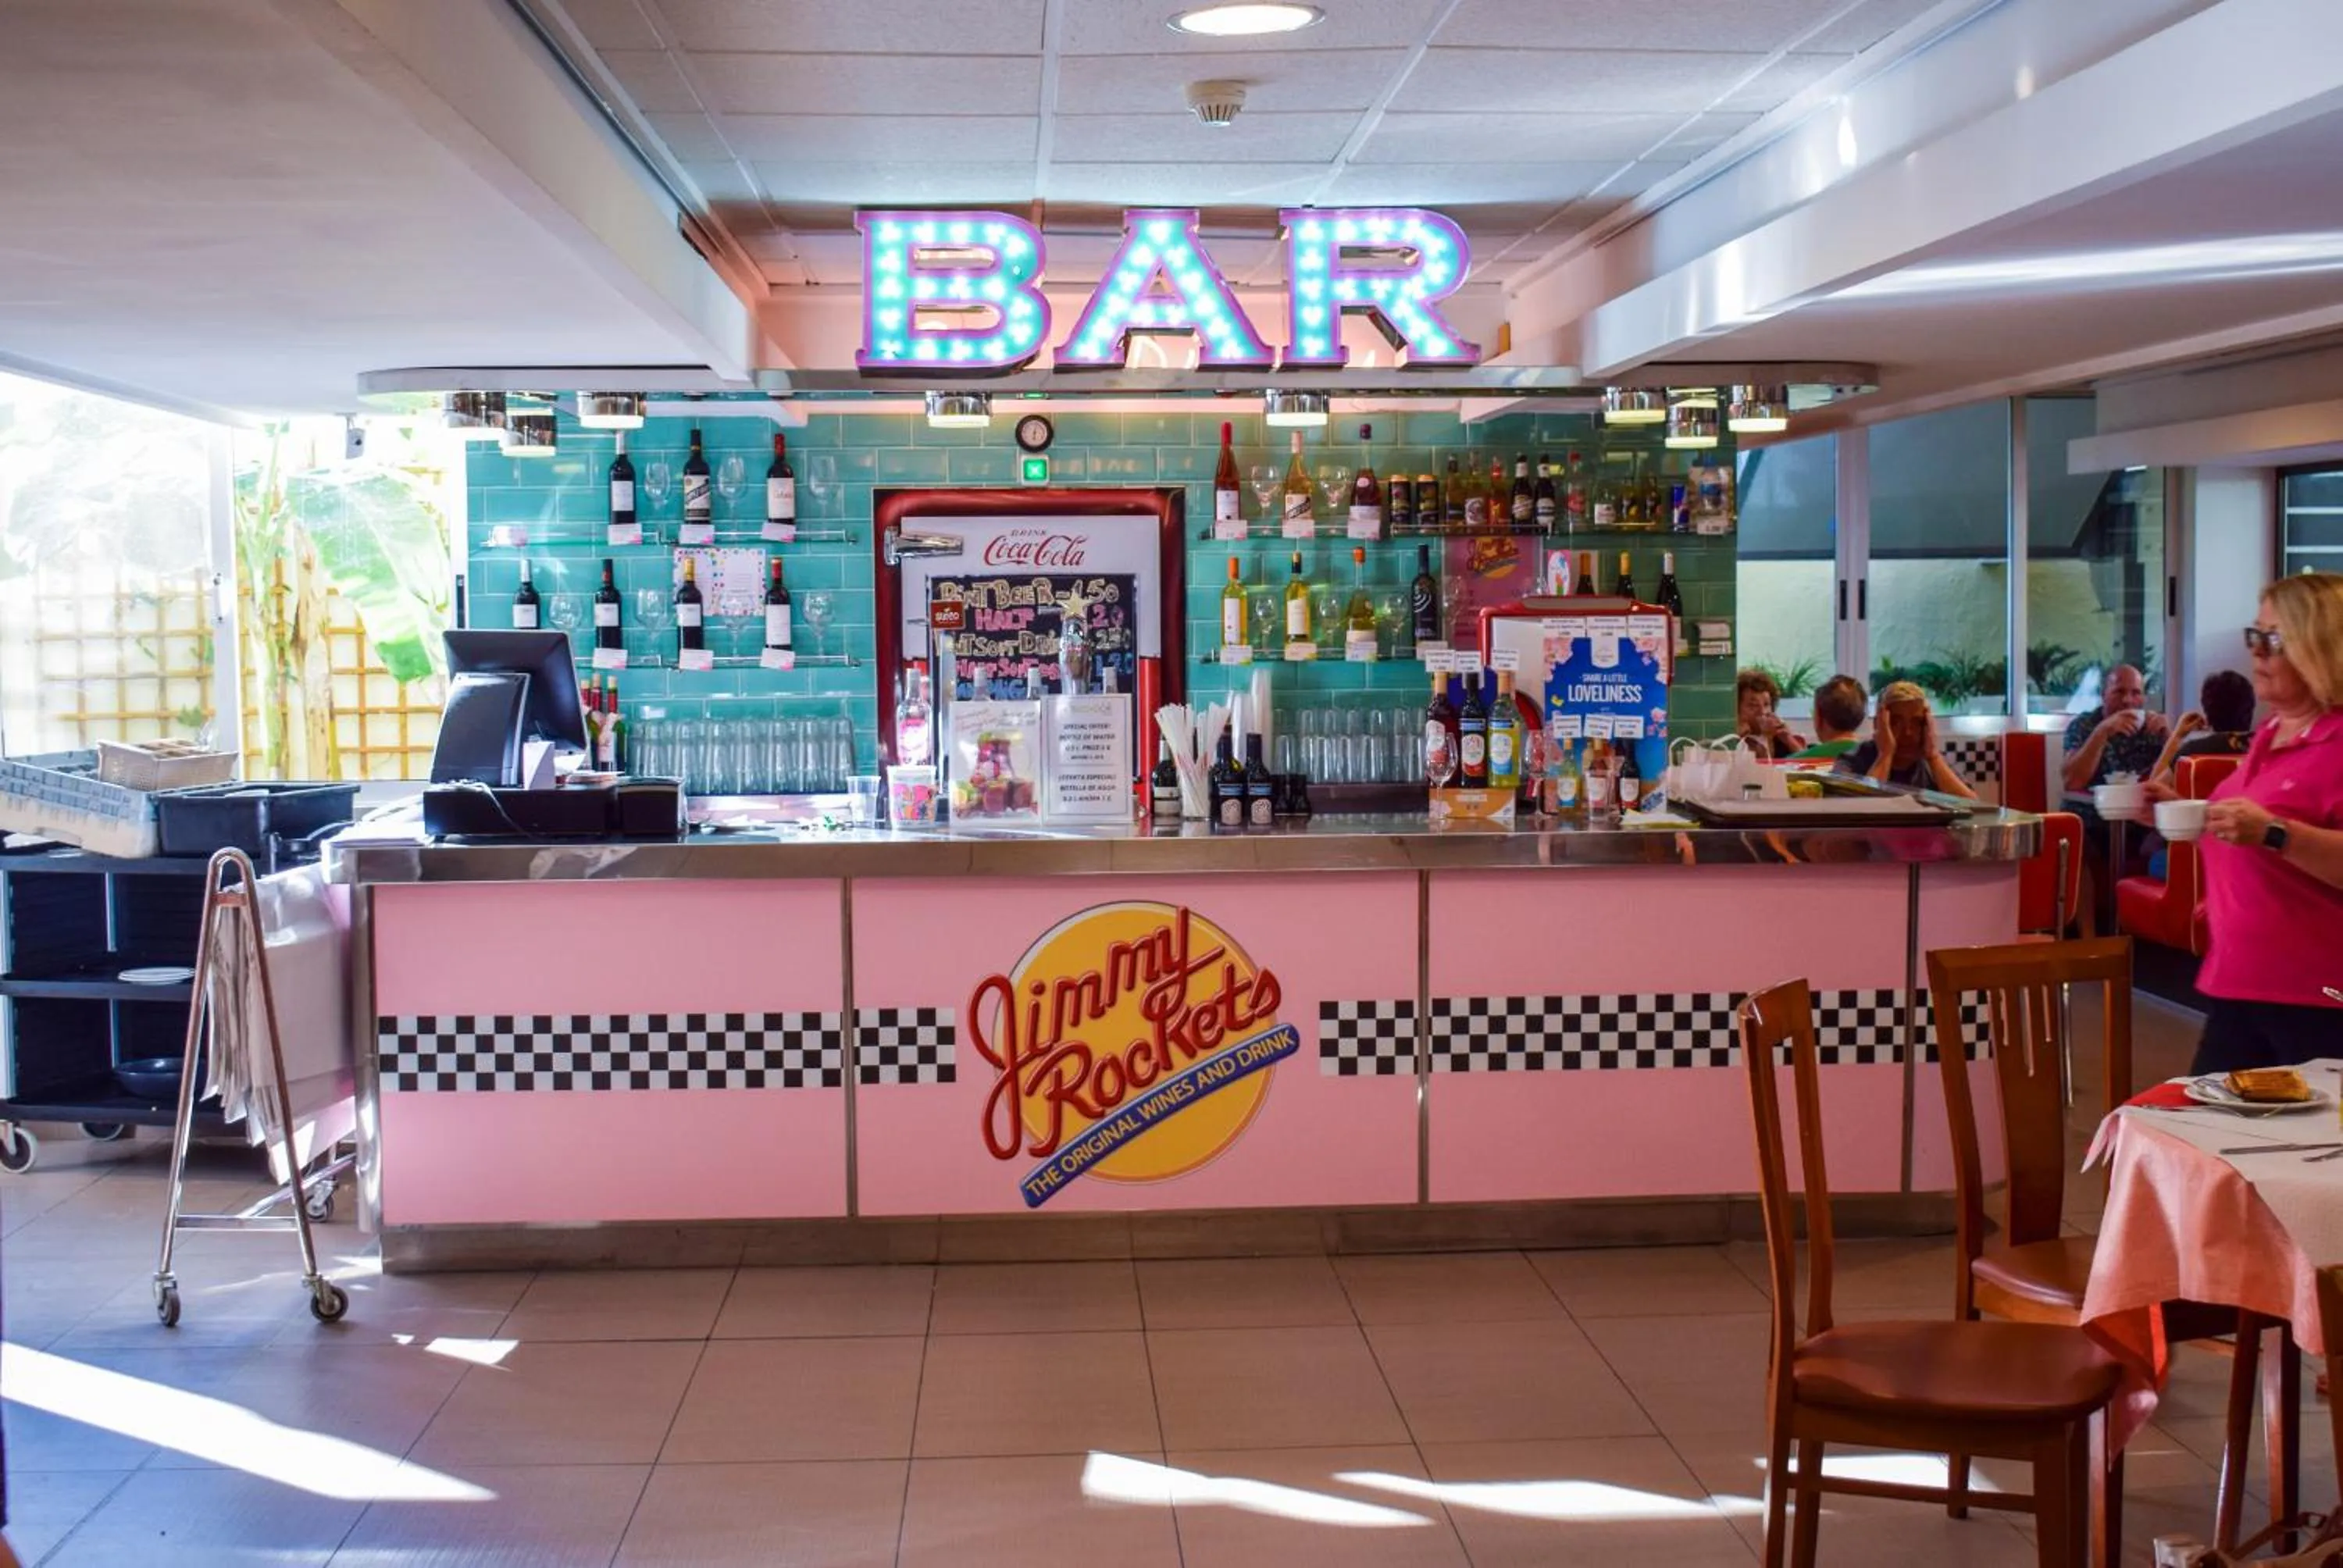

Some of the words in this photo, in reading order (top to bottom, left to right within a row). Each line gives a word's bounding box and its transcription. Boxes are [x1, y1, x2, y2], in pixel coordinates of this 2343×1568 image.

[854, 207, 1482, 374] BAR
[1567, 684, 1642, 703] LOVELINESS
[968, 905, 1226, 1160] Jimmy
[1024, 961, 1282, 1158] Rockets
[1025, 1160, 1065, 1199] THE
[1059, 1114, 1140, 1172] ORIGINAL
[1138, 1081, 1196, 1121] WINES
[1196, 1057, 1238, 1090] AND
[1239, 1029, 1296, 1070] DRINK
